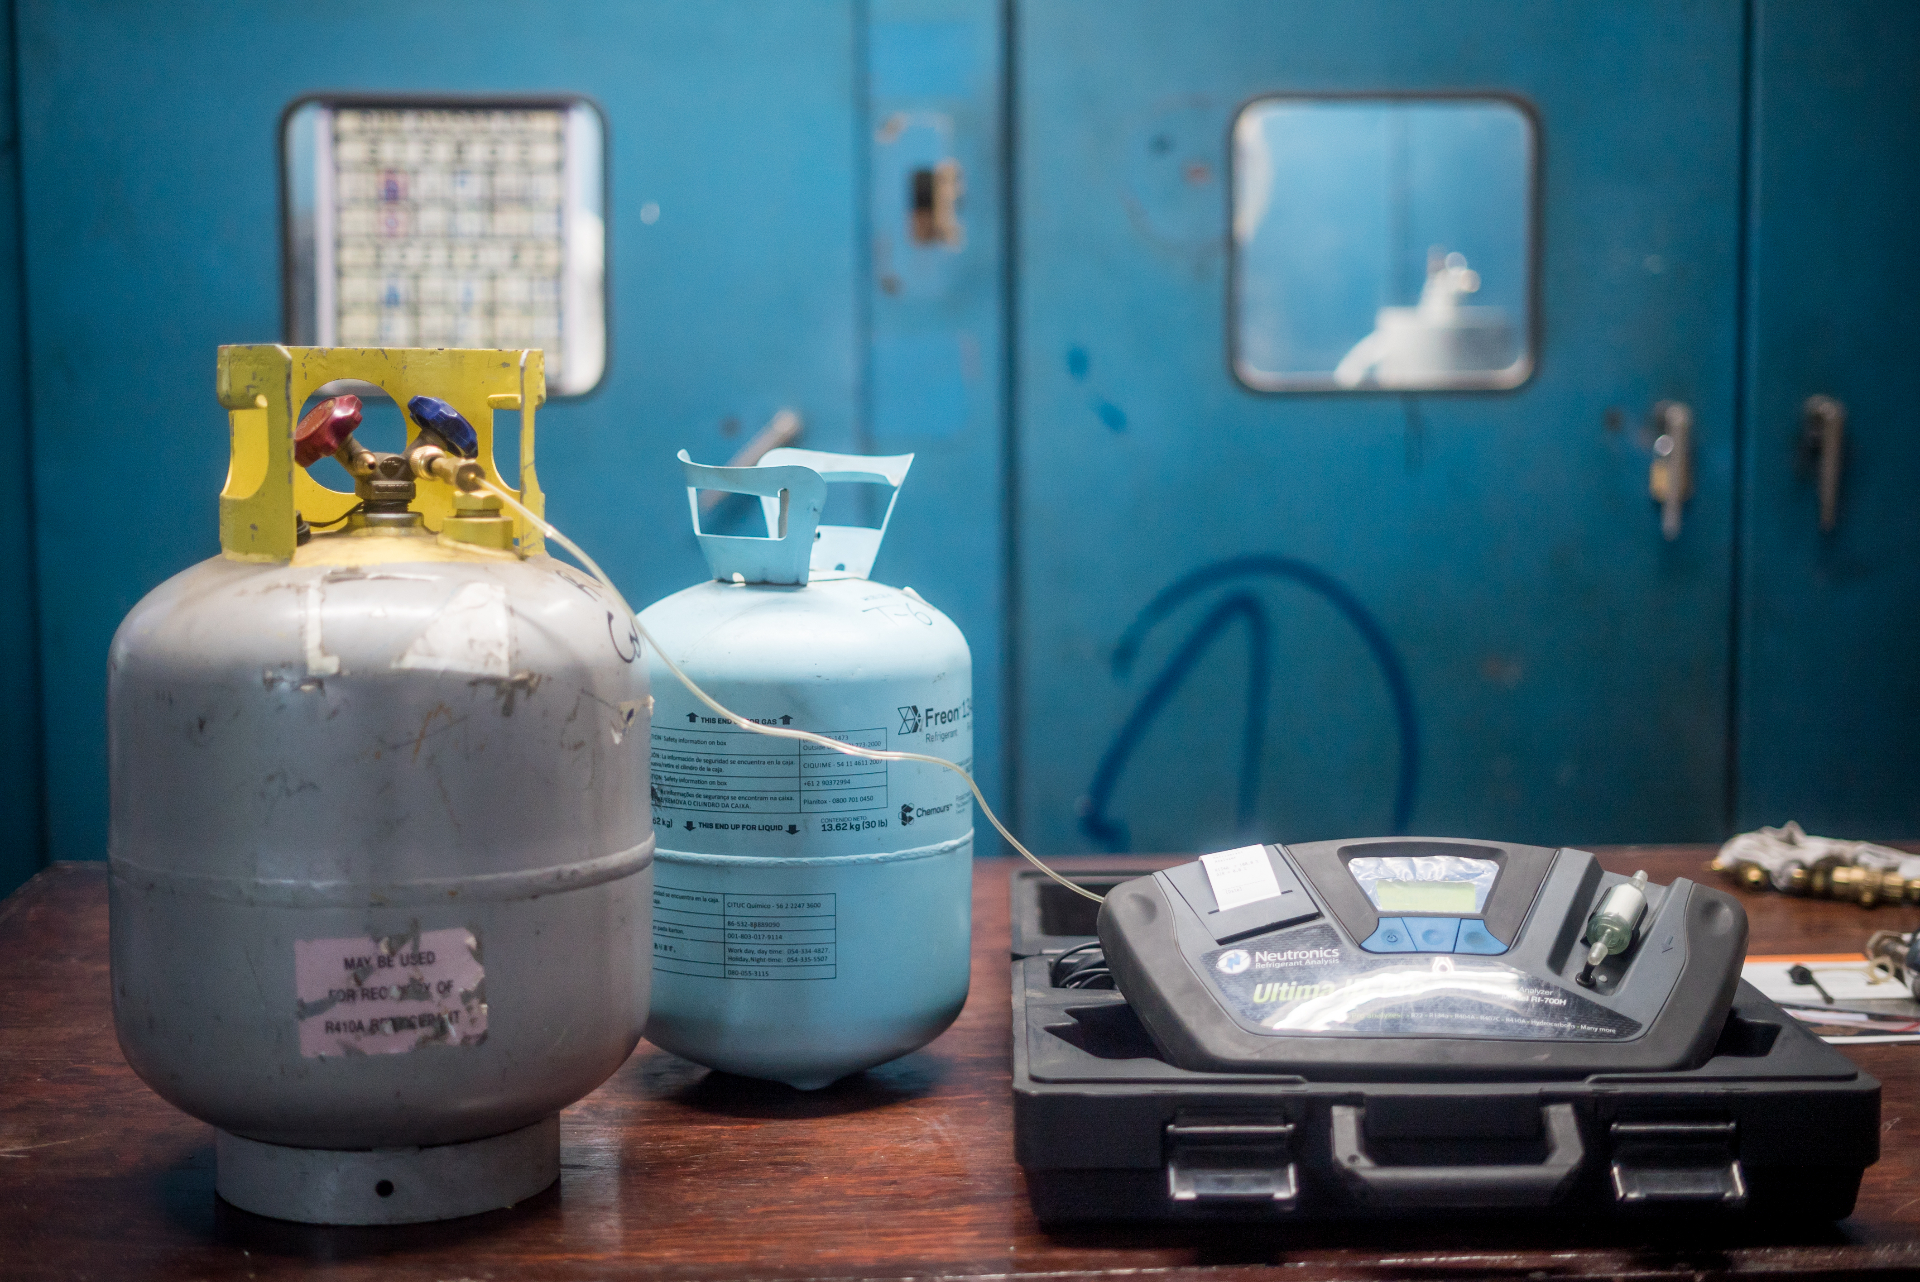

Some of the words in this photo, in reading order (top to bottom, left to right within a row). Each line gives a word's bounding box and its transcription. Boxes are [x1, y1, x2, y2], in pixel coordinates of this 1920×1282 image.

[925, 707, 959, 727] Freon
[926, 729, 958, 743] Refrigerant
[916, 805, 950, 818] Chemours
[821, 822, 848, 832] 13.62
[849, 822, 861, 832] kg
[862, 820, 876, 830] (30
[877, 818, 888, 828] lb)
[344, 956, 371, 970] MAY
[377, 954, 394, 968] BE
[399, 951, 436, 967] USED
[1255, 947, 1340, 962] Neutronics
[1256, 960, 1302, 969] Refrigerant
[1305, 958, 1340, 966] Analysis
[328, 988, 356, 1002] FOR
[436, 980, 454, 994] OF
[1253, 980, 1336, 1003] Ultima
[1518, 986, 1554, 996] Analyzer
[1530, 996, 1567, 1006] RI-700H
[1580, 1024, 1598, 1032] Many
